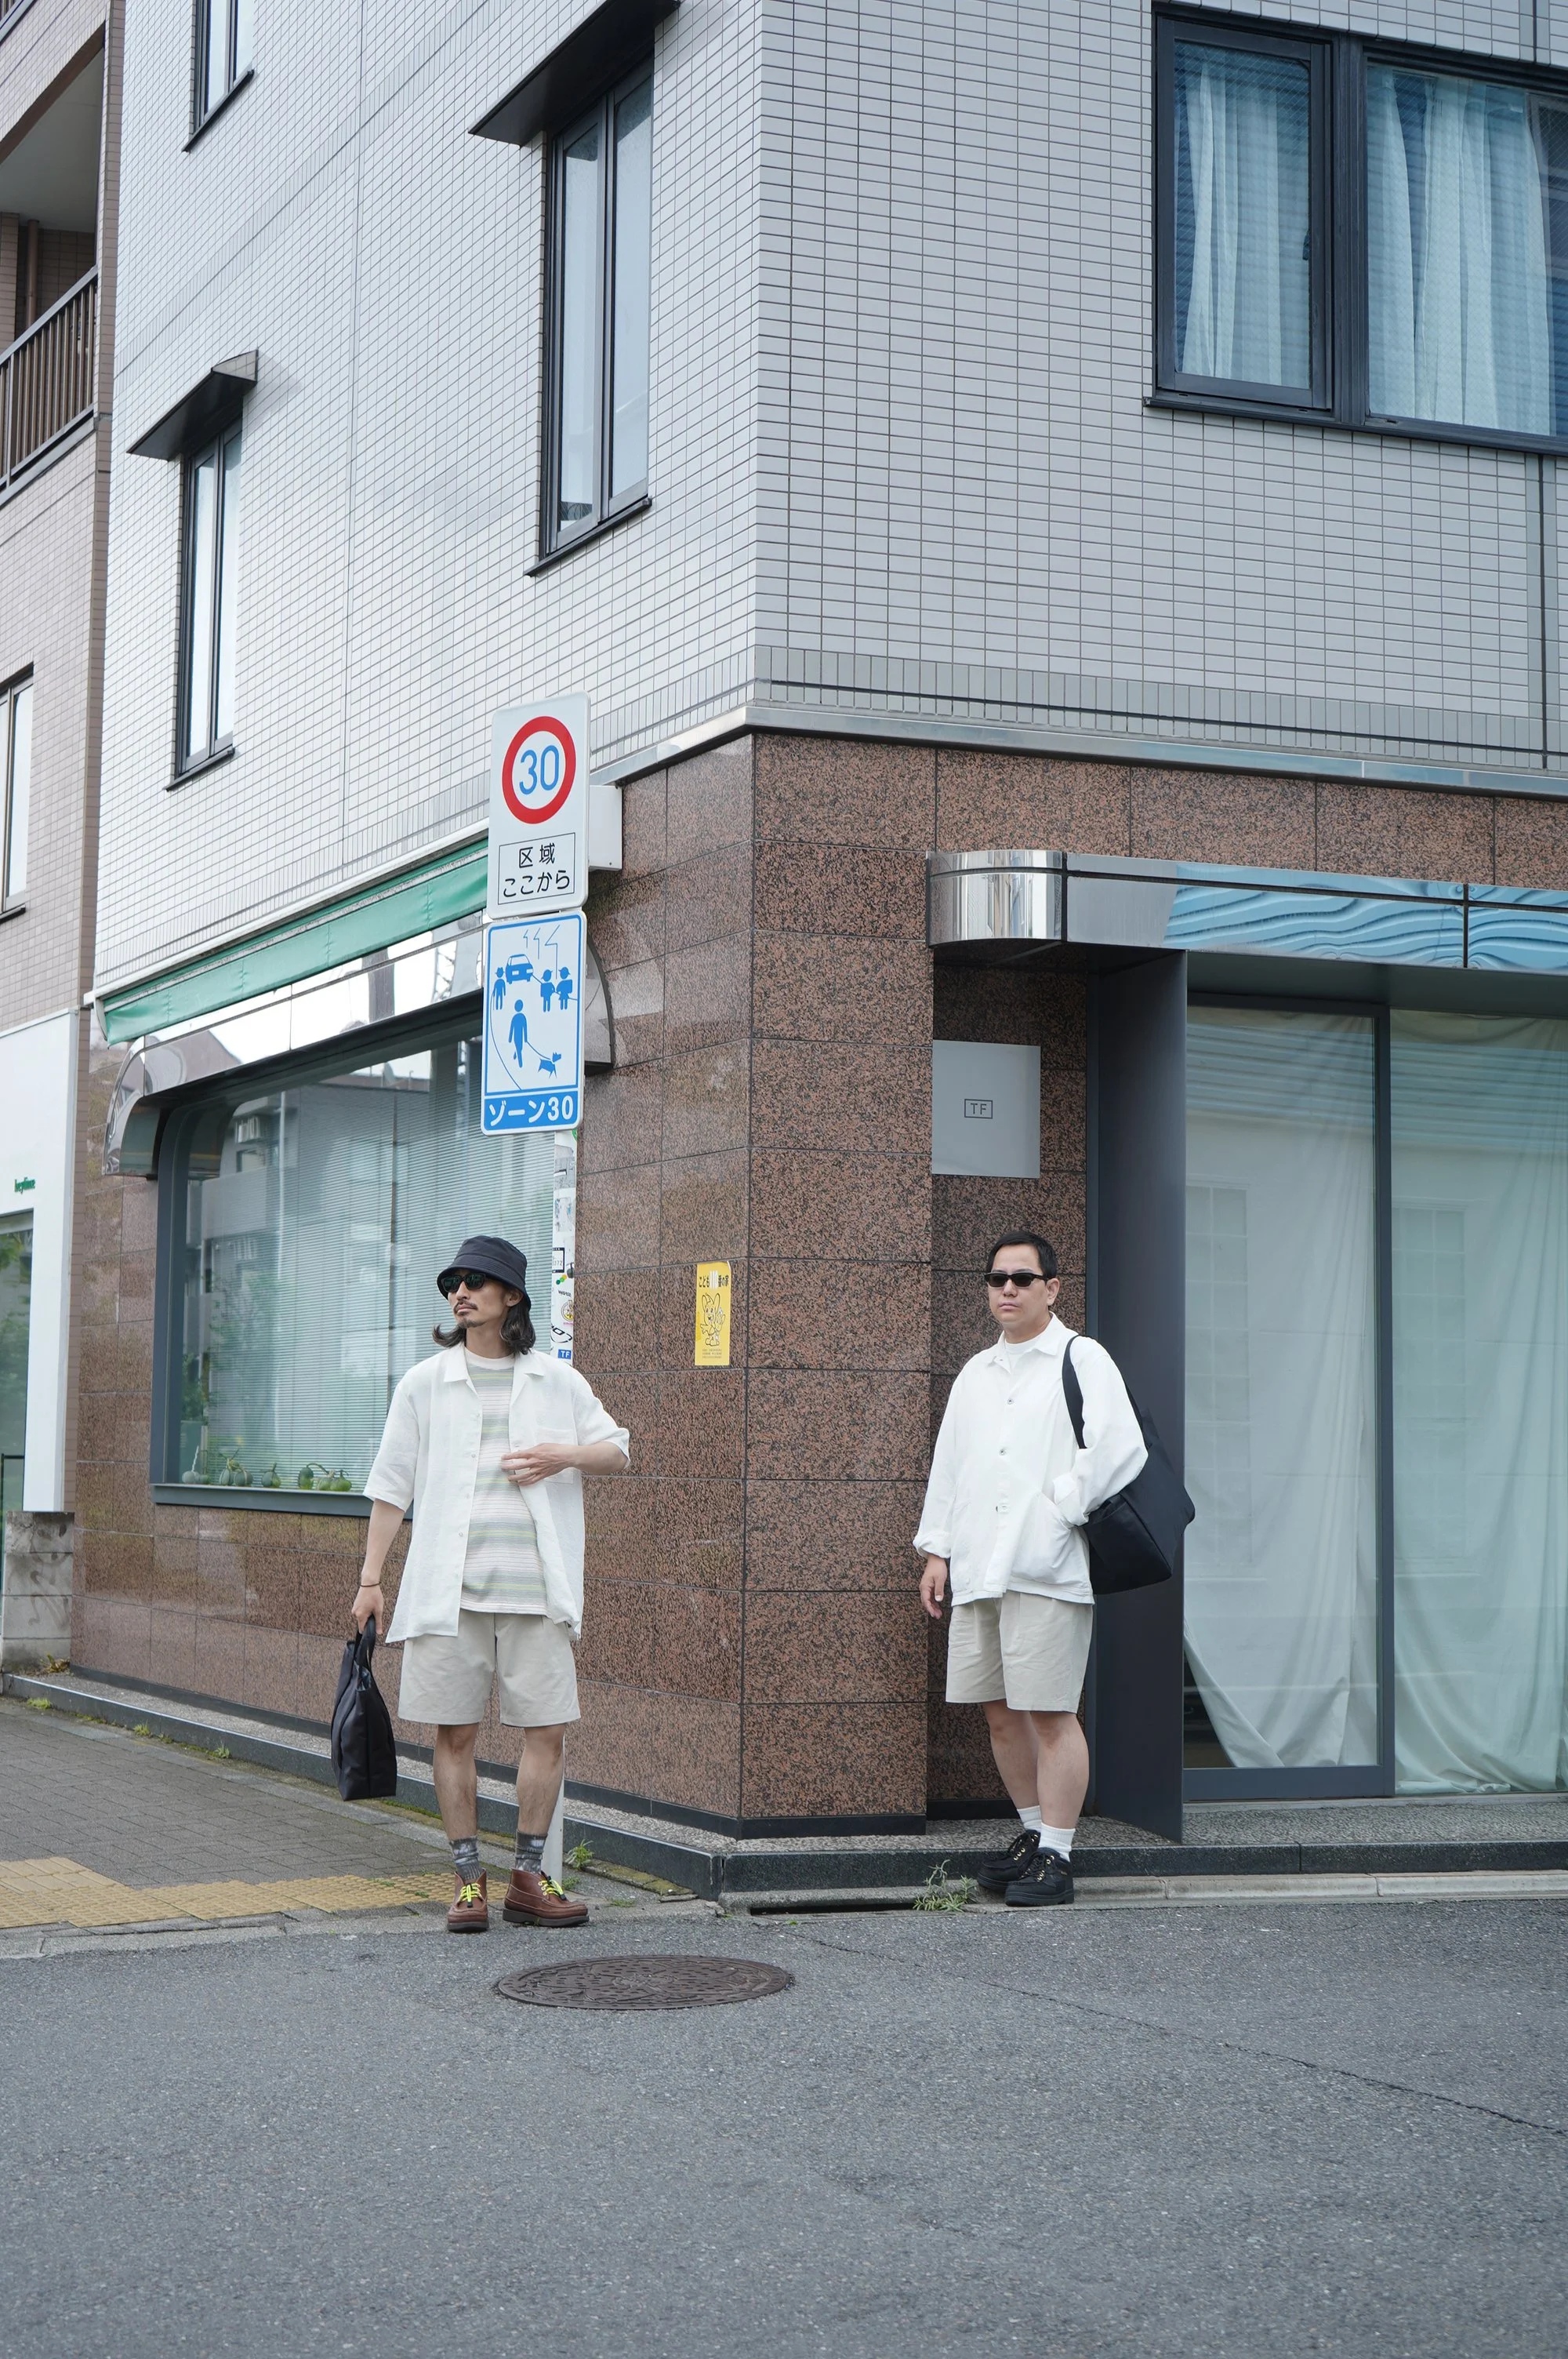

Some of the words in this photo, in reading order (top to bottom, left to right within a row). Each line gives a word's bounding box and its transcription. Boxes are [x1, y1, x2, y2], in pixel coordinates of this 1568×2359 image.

[519, 745, 560, 795] 30
[519, 842, 556, 868] 区域
[503, 870, 570, 897] ここから
[489, 1095, 574, 1126] ゾーン30
[970, 1103, 987, 1115] TF
